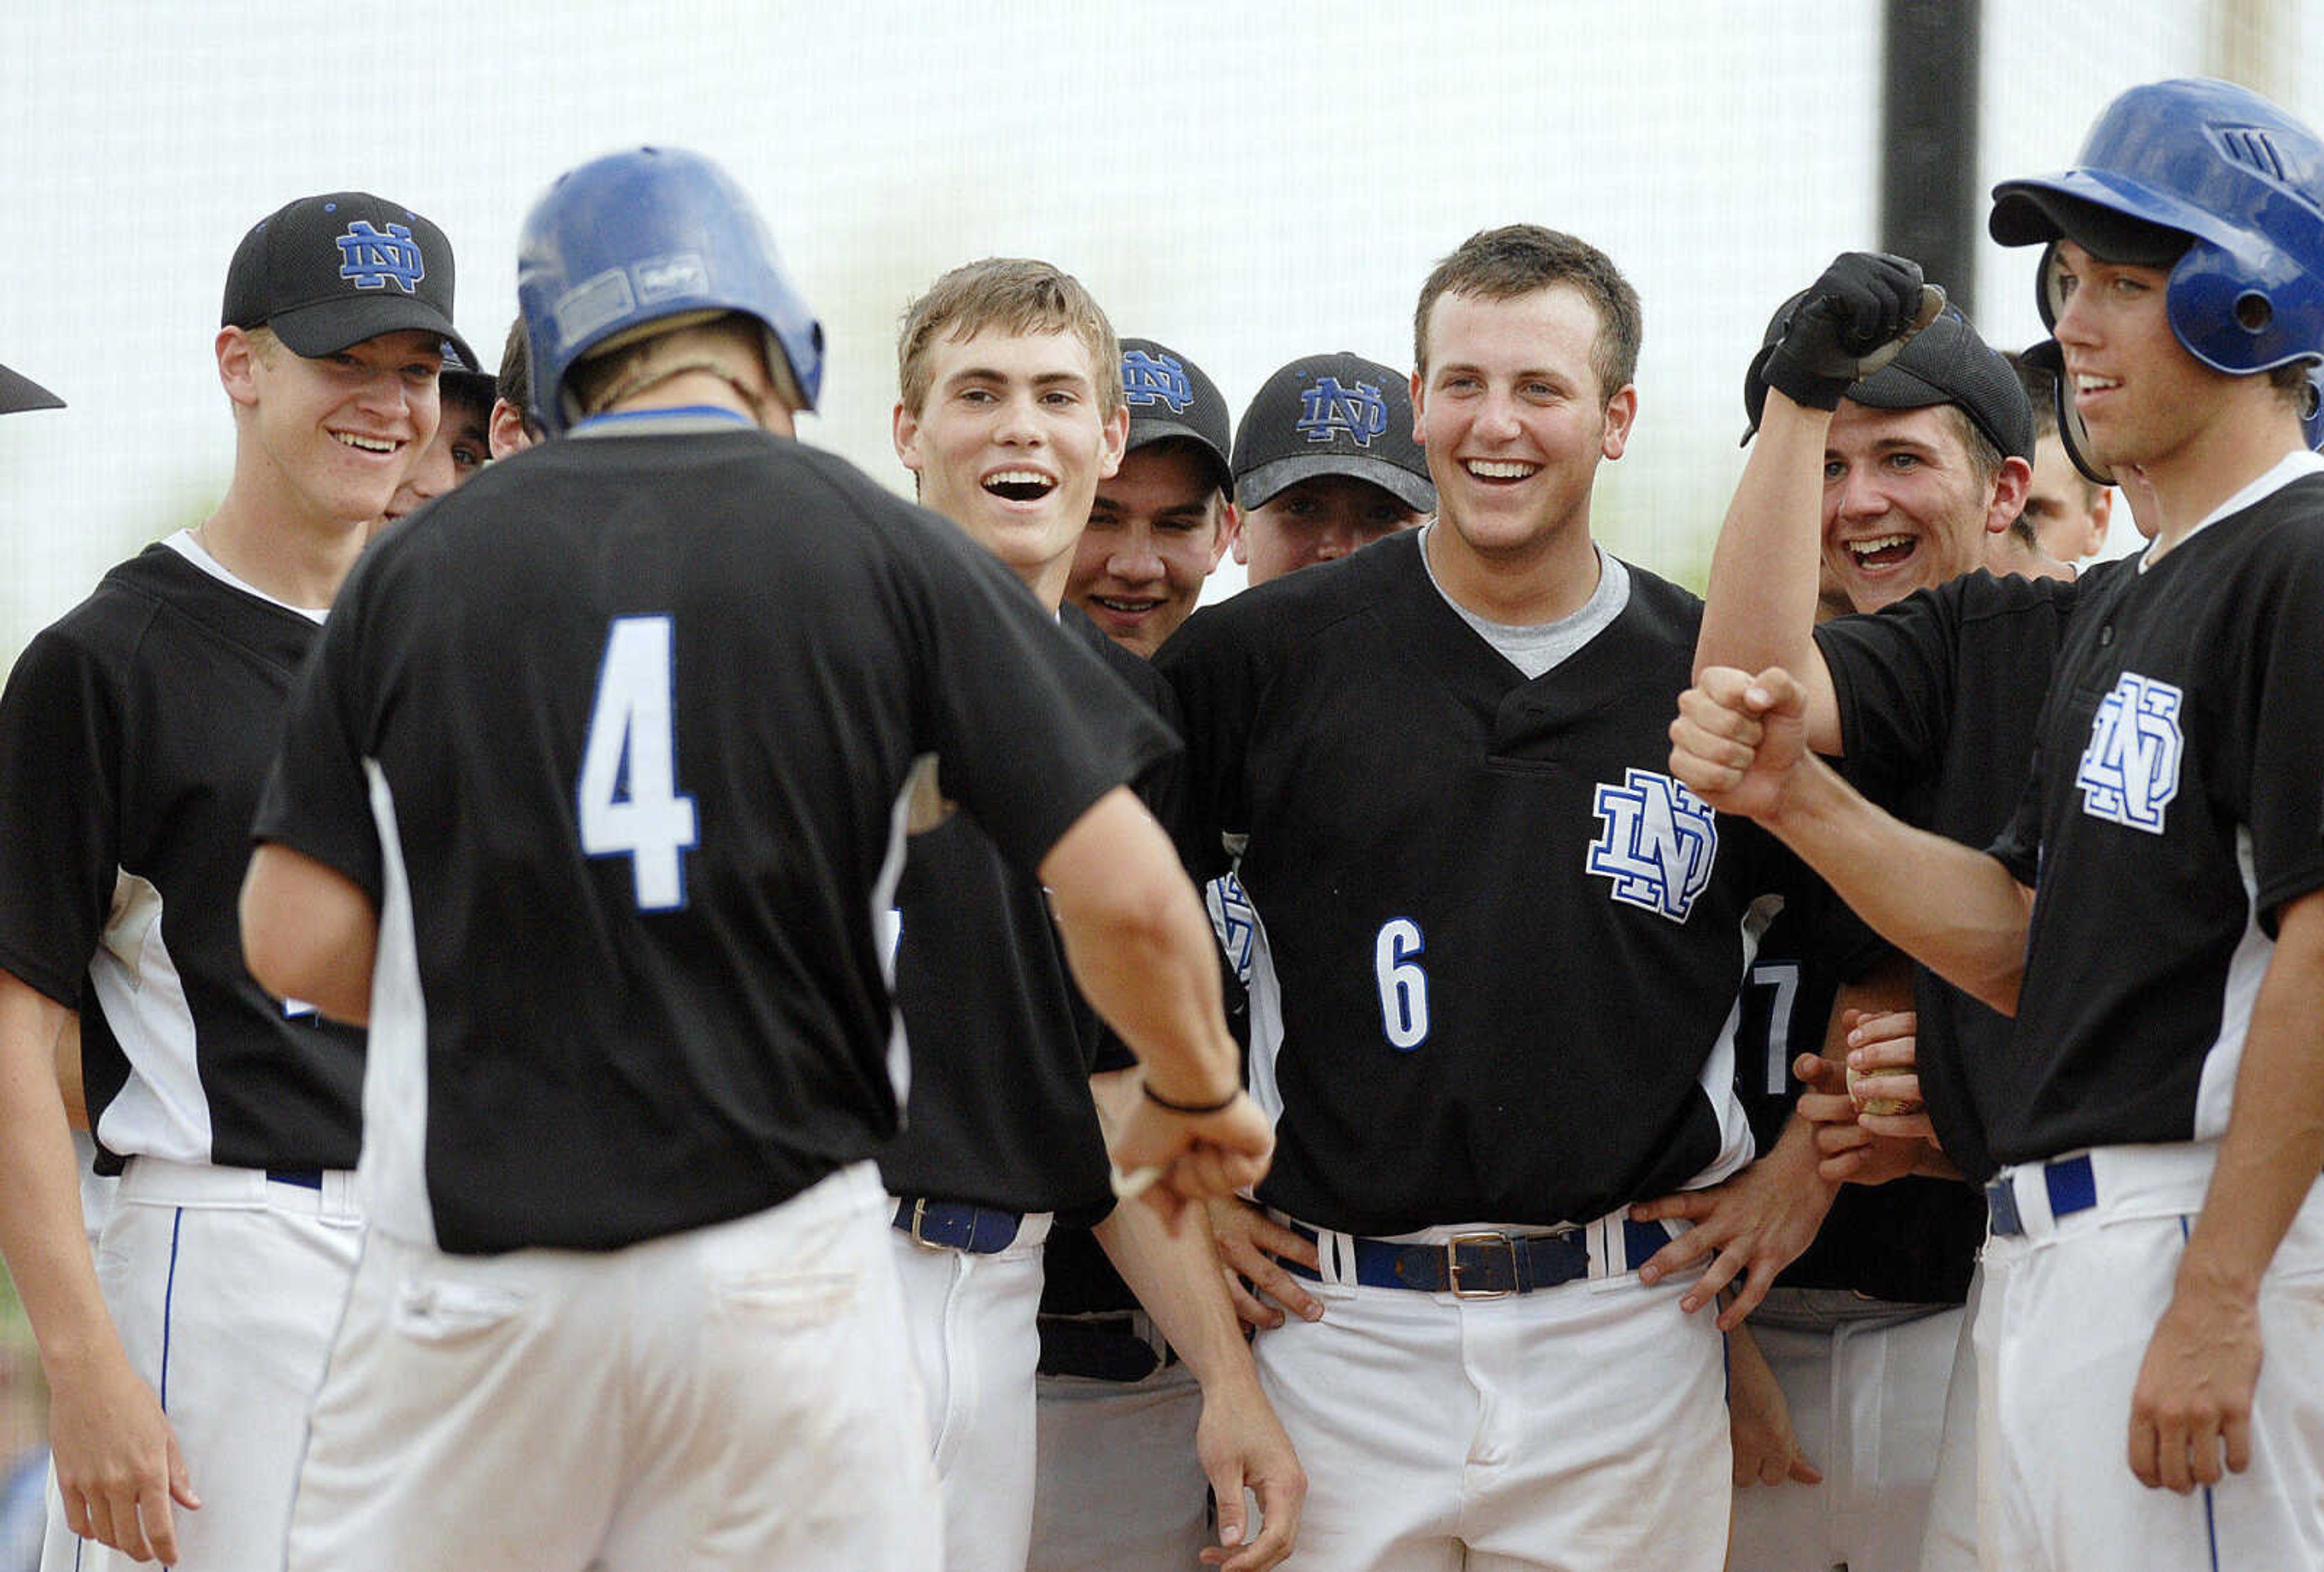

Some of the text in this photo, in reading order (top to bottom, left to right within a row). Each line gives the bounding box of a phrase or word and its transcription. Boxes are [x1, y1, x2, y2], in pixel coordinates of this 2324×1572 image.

[336, 220, 425, 292] ND
[1296, 377, 1388, 447] ND
[577, 613, 700, 914] 4
[2075, 671, 2184, 834] ND
[1586, 767, 1718, 924] ND
[1375, 916, 1430, 1052] 6
[1753, 959, 1800, 1094] 7
